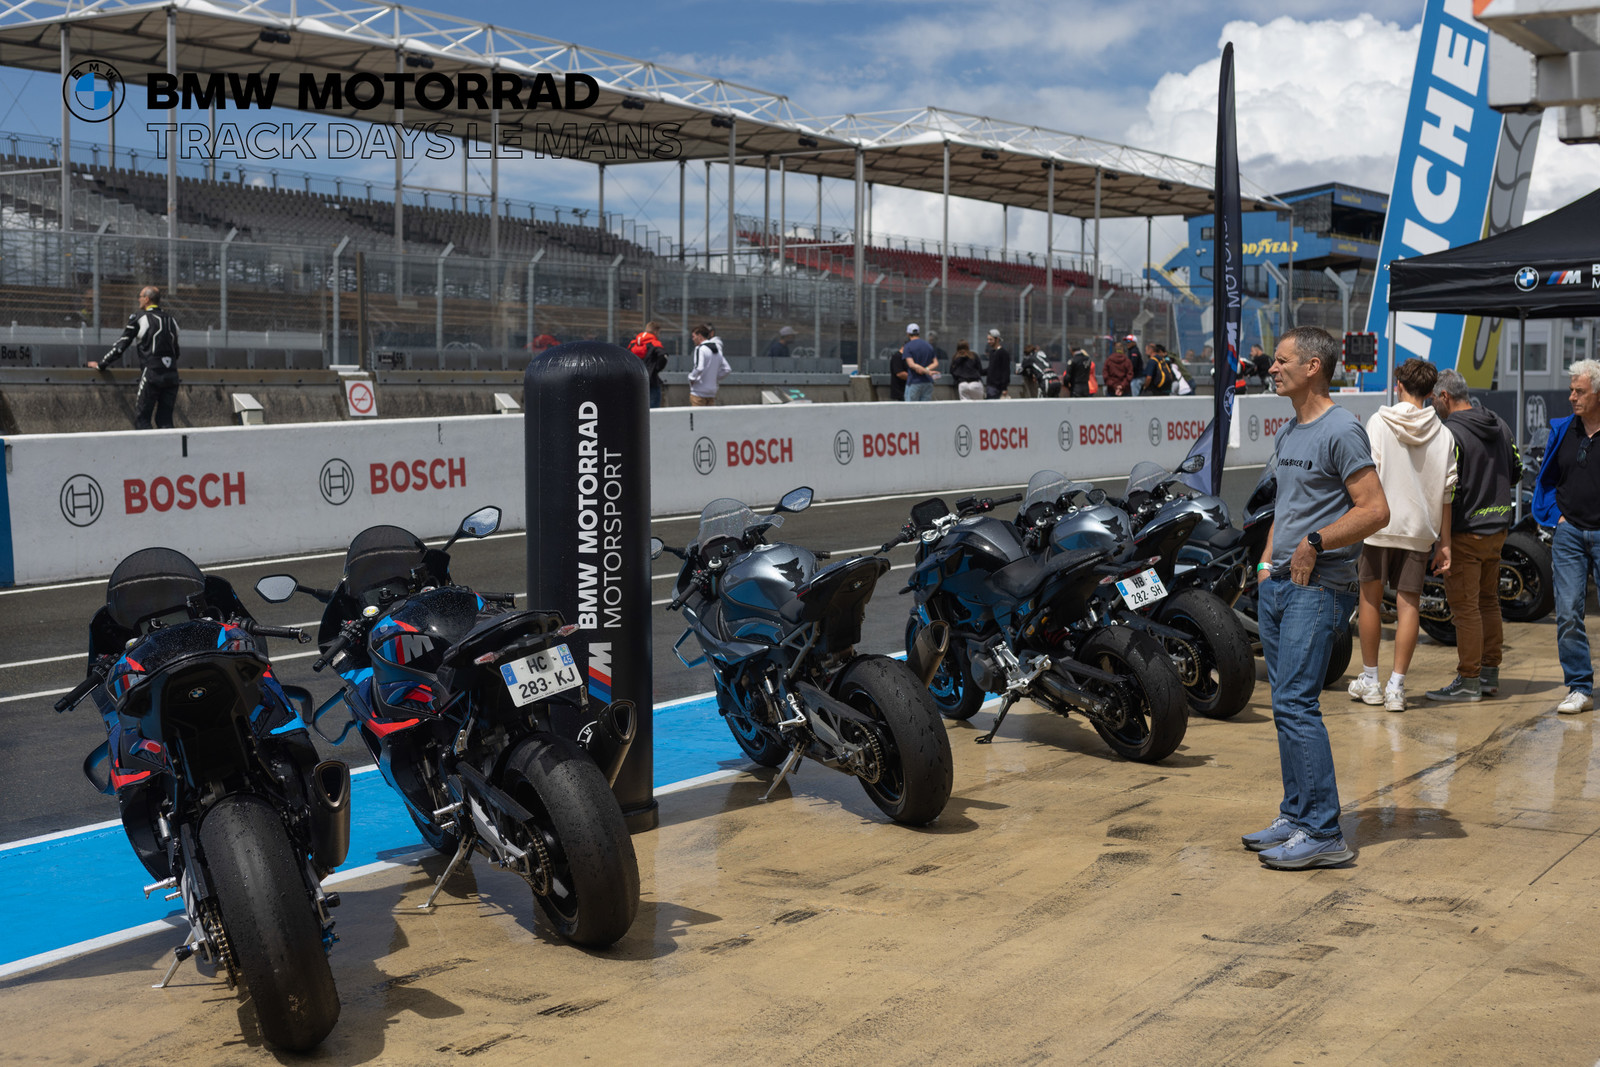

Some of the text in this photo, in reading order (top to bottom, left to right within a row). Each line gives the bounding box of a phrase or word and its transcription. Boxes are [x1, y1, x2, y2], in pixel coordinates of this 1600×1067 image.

[1242, 239, 1298, 257] ODYEAR
[1, 346, 30, 360] Box 54
[979, 427, 1028, 451] BOSCH
[1079, 423, 1123, 446] BOSCH
[1167, 420, 1205, 441] BOSCH
[1264, 417, 1291, 437] BOS
[726, 437, 793, 467] BOSCH
[862, 431, 920, 458] BOSCH
[369, 457, 467, 495] BOSCH
[124, 471, 246, 515] BOSCH
[578, 401, 598, 630] BMW MOTORRAD
[603, 447, 622, 628] MOTORSPORT
